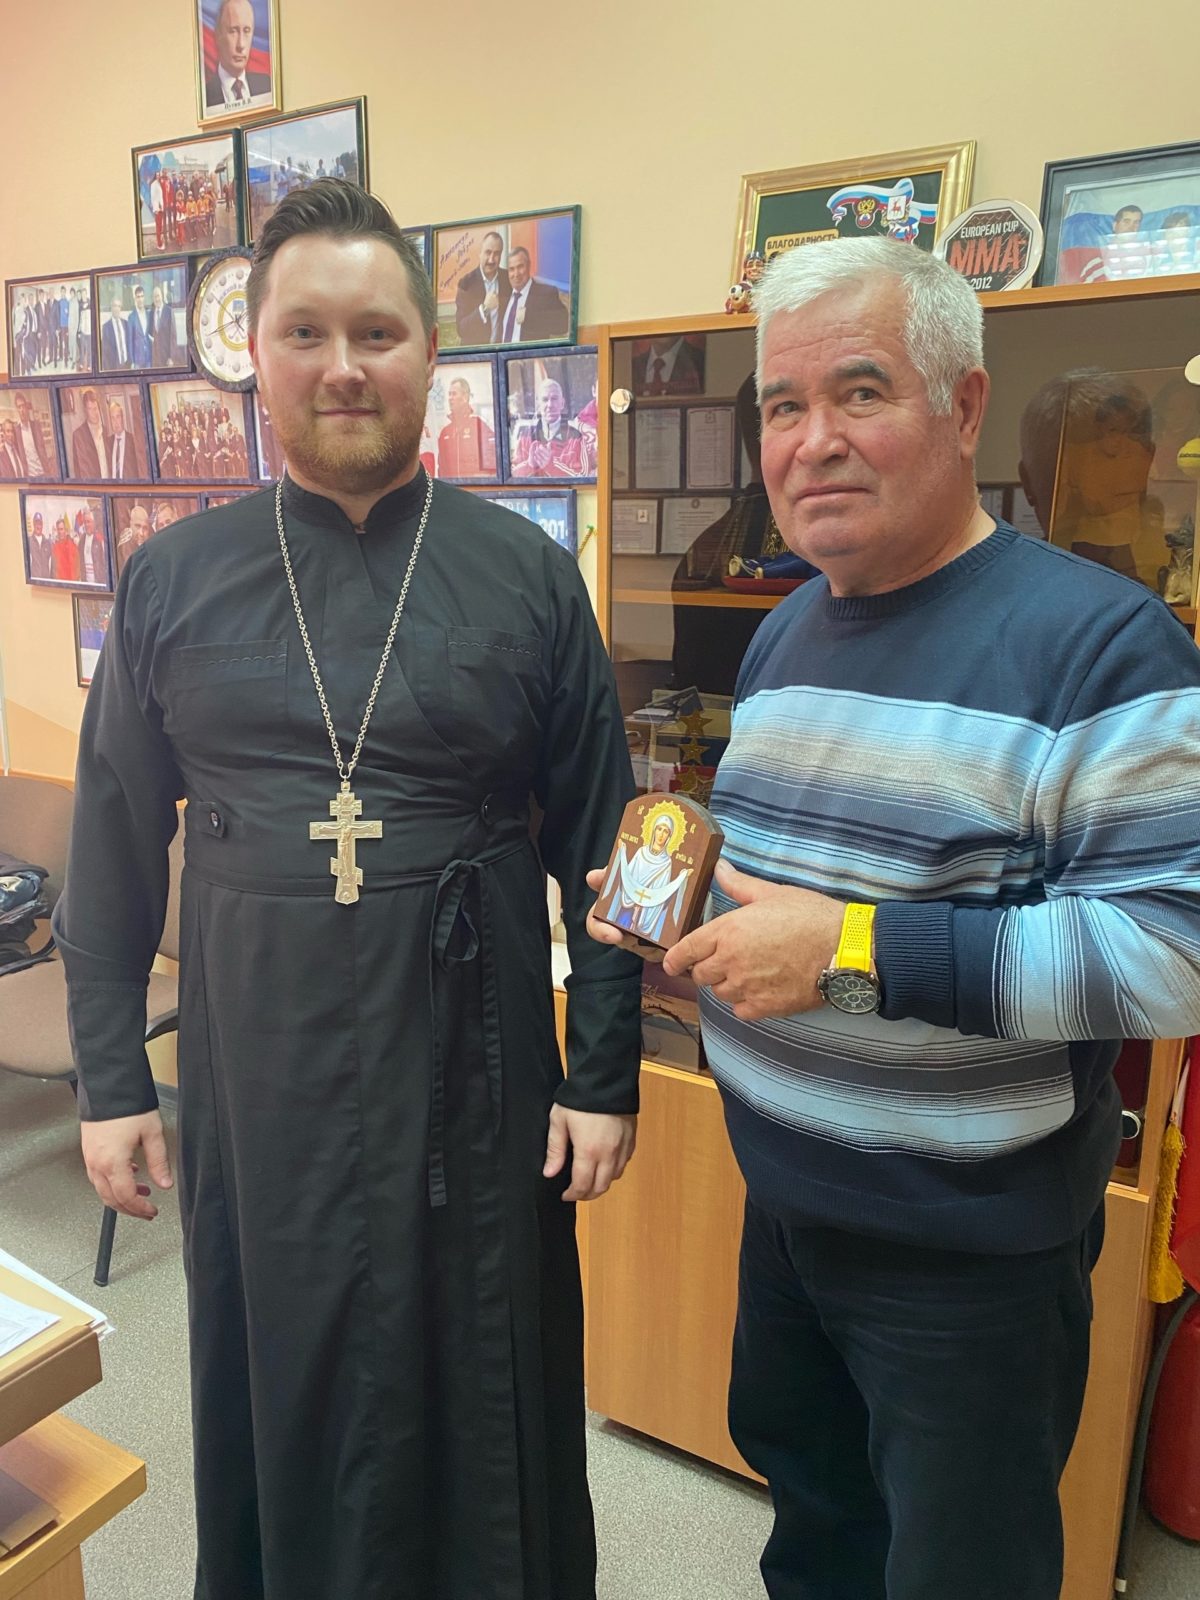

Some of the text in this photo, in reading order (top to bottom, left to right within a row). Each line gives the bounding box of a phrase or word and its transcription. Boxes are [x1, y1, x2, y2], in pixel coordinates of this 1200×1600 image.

[960, 220, 1019, 238] EUROPEAN CUP
[950, 233, 1027, 277] MMA
[970, 276, 993, 290] 2012
